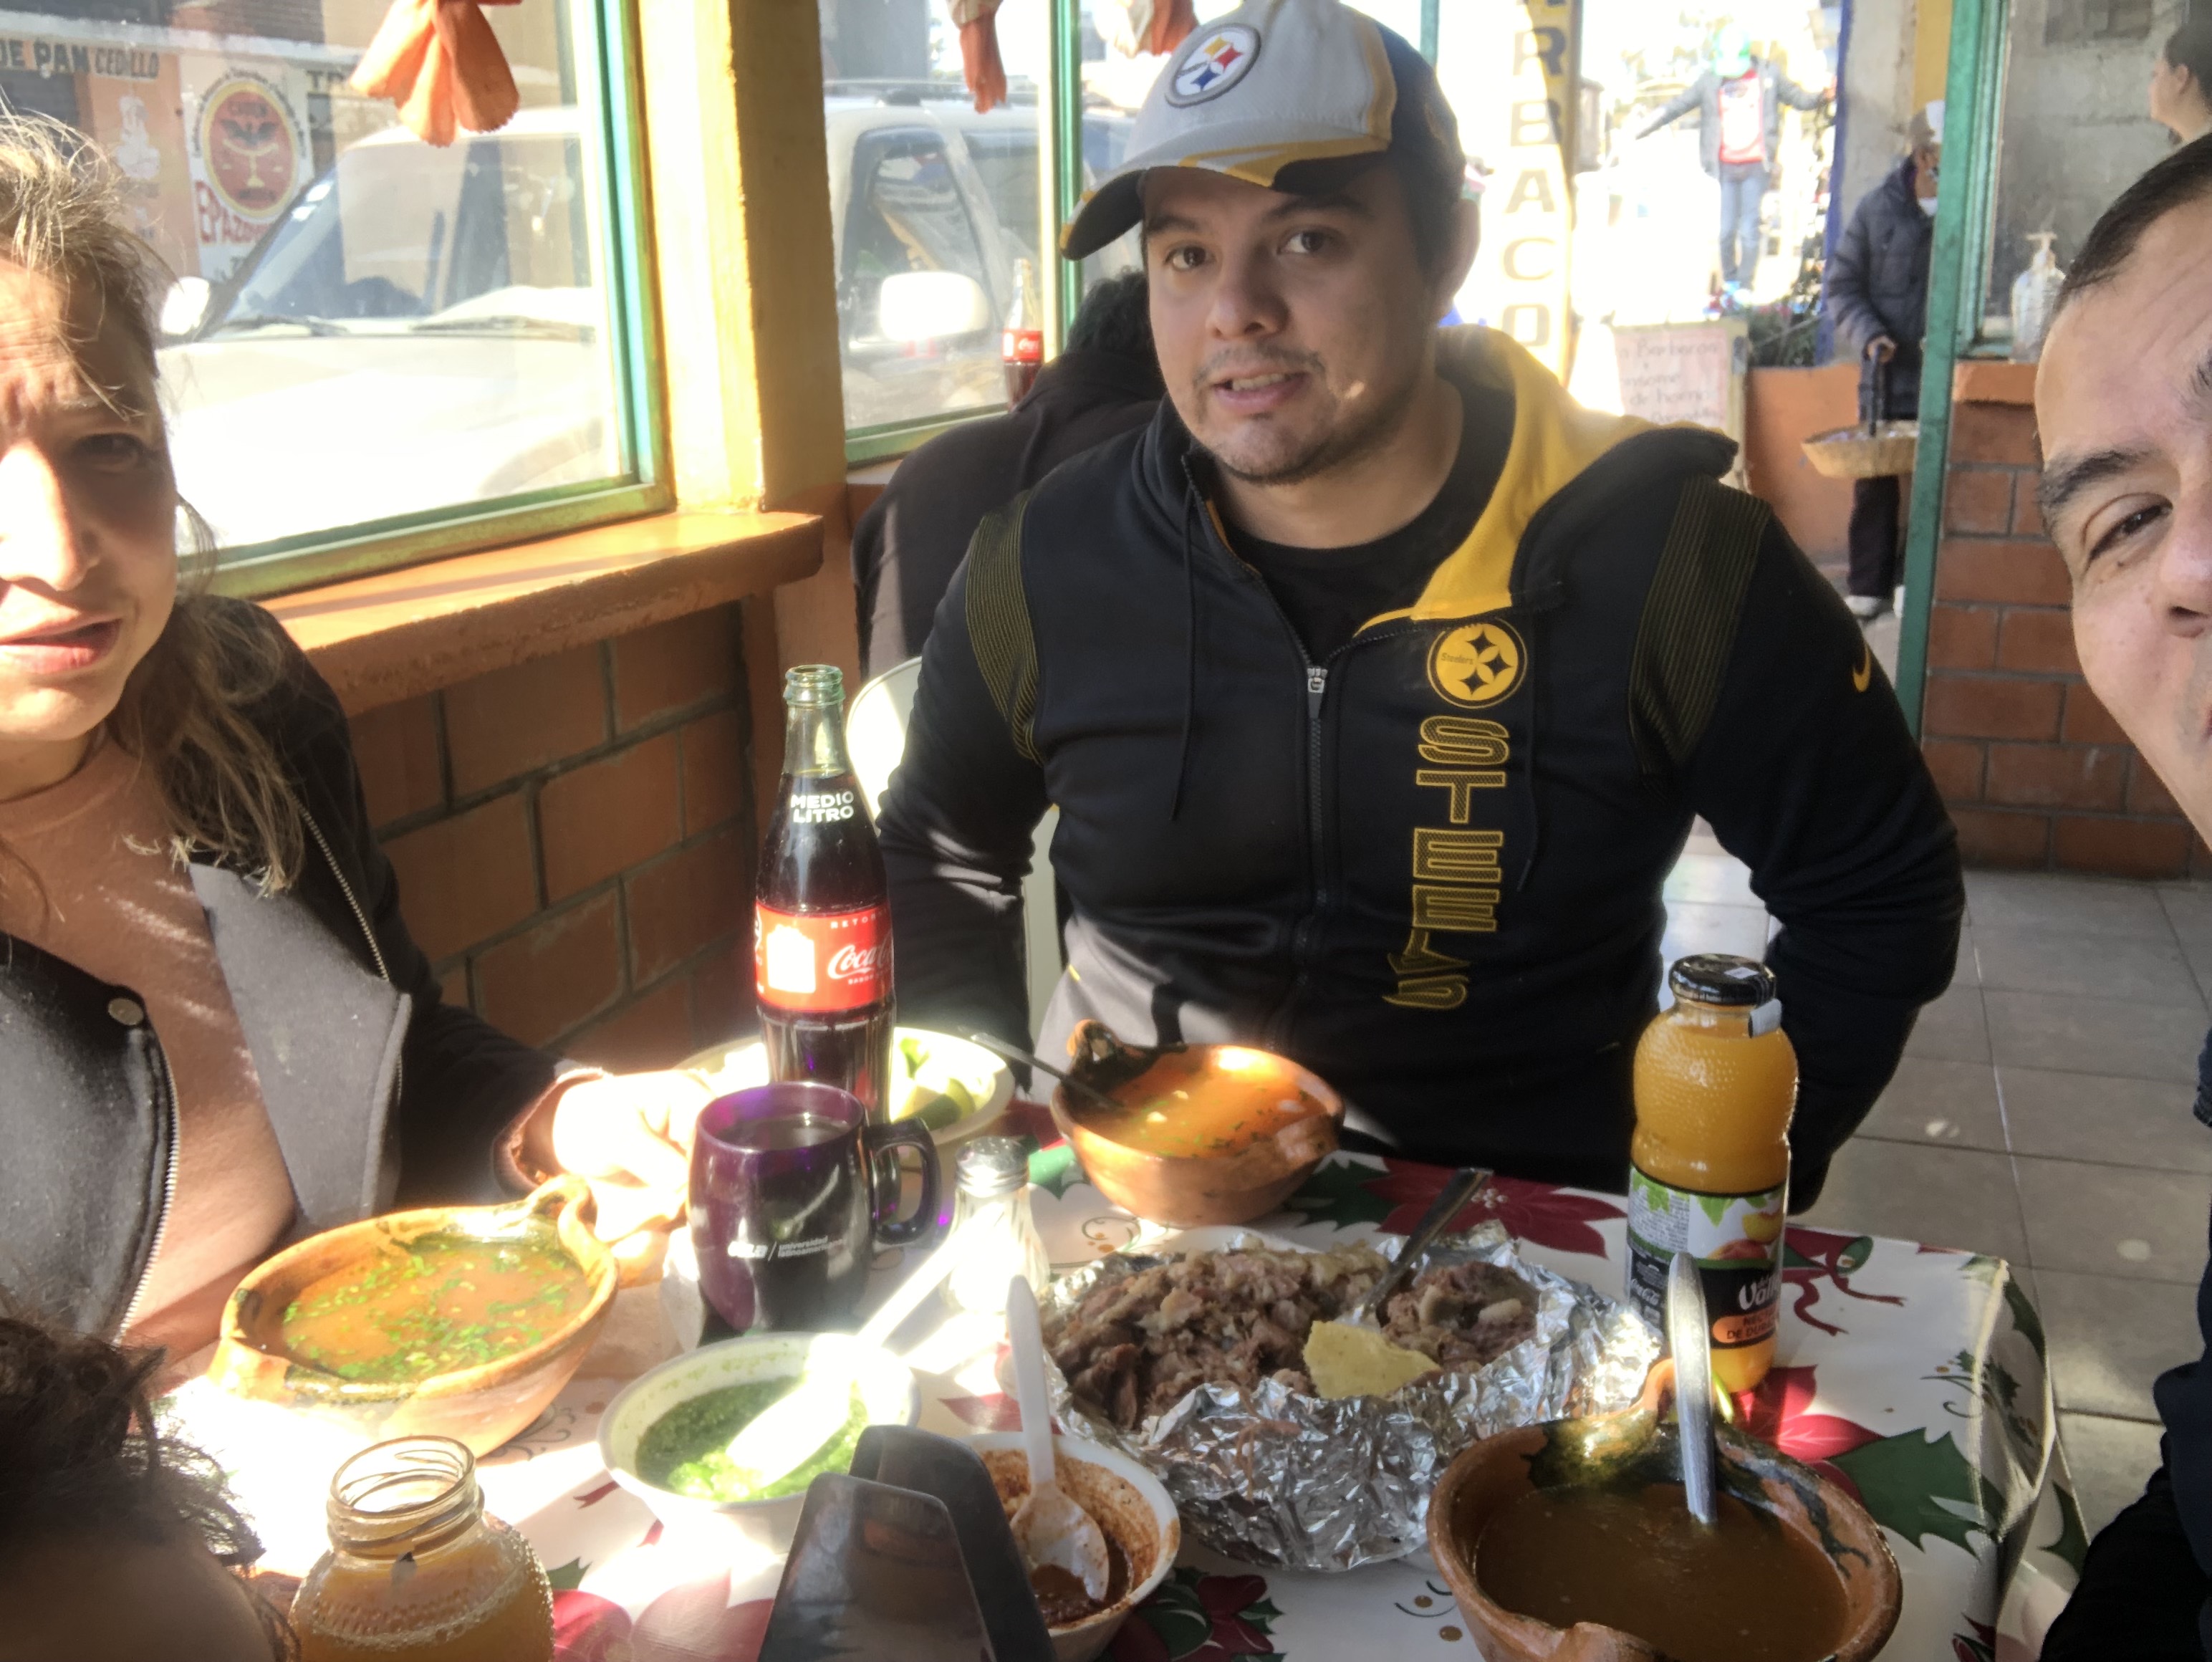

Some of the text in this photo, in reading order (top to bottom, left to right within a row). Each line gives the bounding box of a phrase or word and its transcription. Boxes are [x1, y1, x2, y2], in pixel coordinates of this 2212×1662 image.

[34, 39, 90, 72] PAN
[791, 791, 854, 809] MEDIO
[793, 804, 854, 823] LITRO
